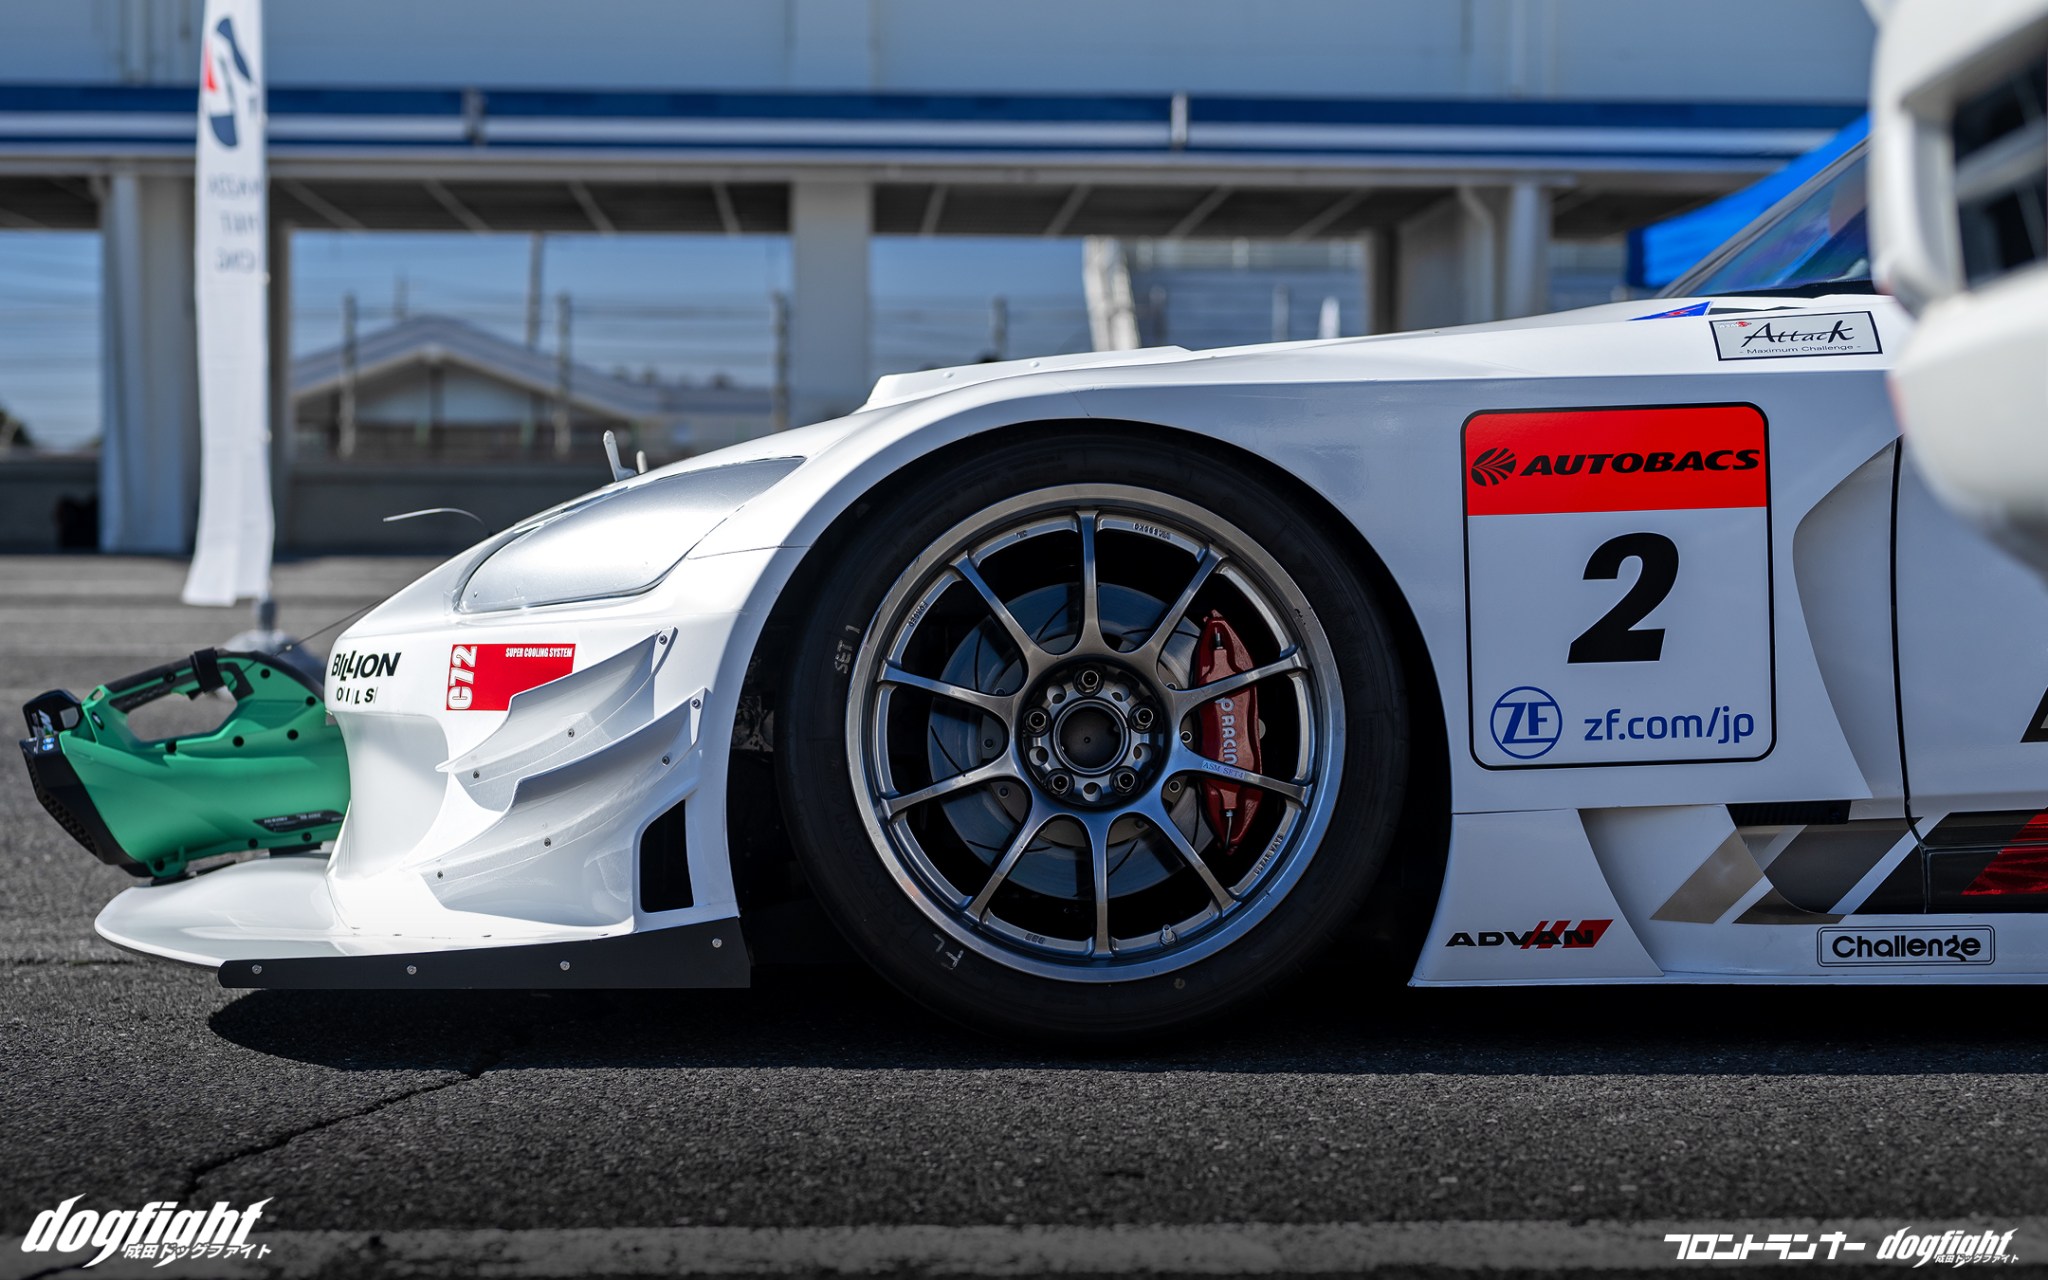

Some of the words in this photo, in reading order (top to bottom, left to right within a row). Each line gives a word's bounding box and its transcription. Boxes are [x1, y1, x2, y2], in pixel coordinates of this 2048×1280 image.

[1740, 319, 1855, 348] Attack
[1746, 346, 1799, 355] Maximum
[1801, 344, 1854, 352] Challenge
[1519, 448, 1760, 477] AUTOBACS
[1567, 532, 1679, 664] 2
[330, 650, 402, 682] BILLION
[505, 646, 524, 659] SUPER
[523, 646, 549, 659] COOLING
[548, 646, 573, 659] SYSTEM
[834, 639, 853, 674] SET
[447, 644, 478, 711] C72
[1495, 700, 1558, 746] ZF
[1583, 705, 1755, 745] zf.com/jp
[1221, 714, 1239, 765] RACIN
[1202, 761, 1221, 772] ASM
[932, 932, 965, 970] FL
[1445, 929, 1594, 947] ADVAN
[1832, 934, 1982, 962] Challenge
